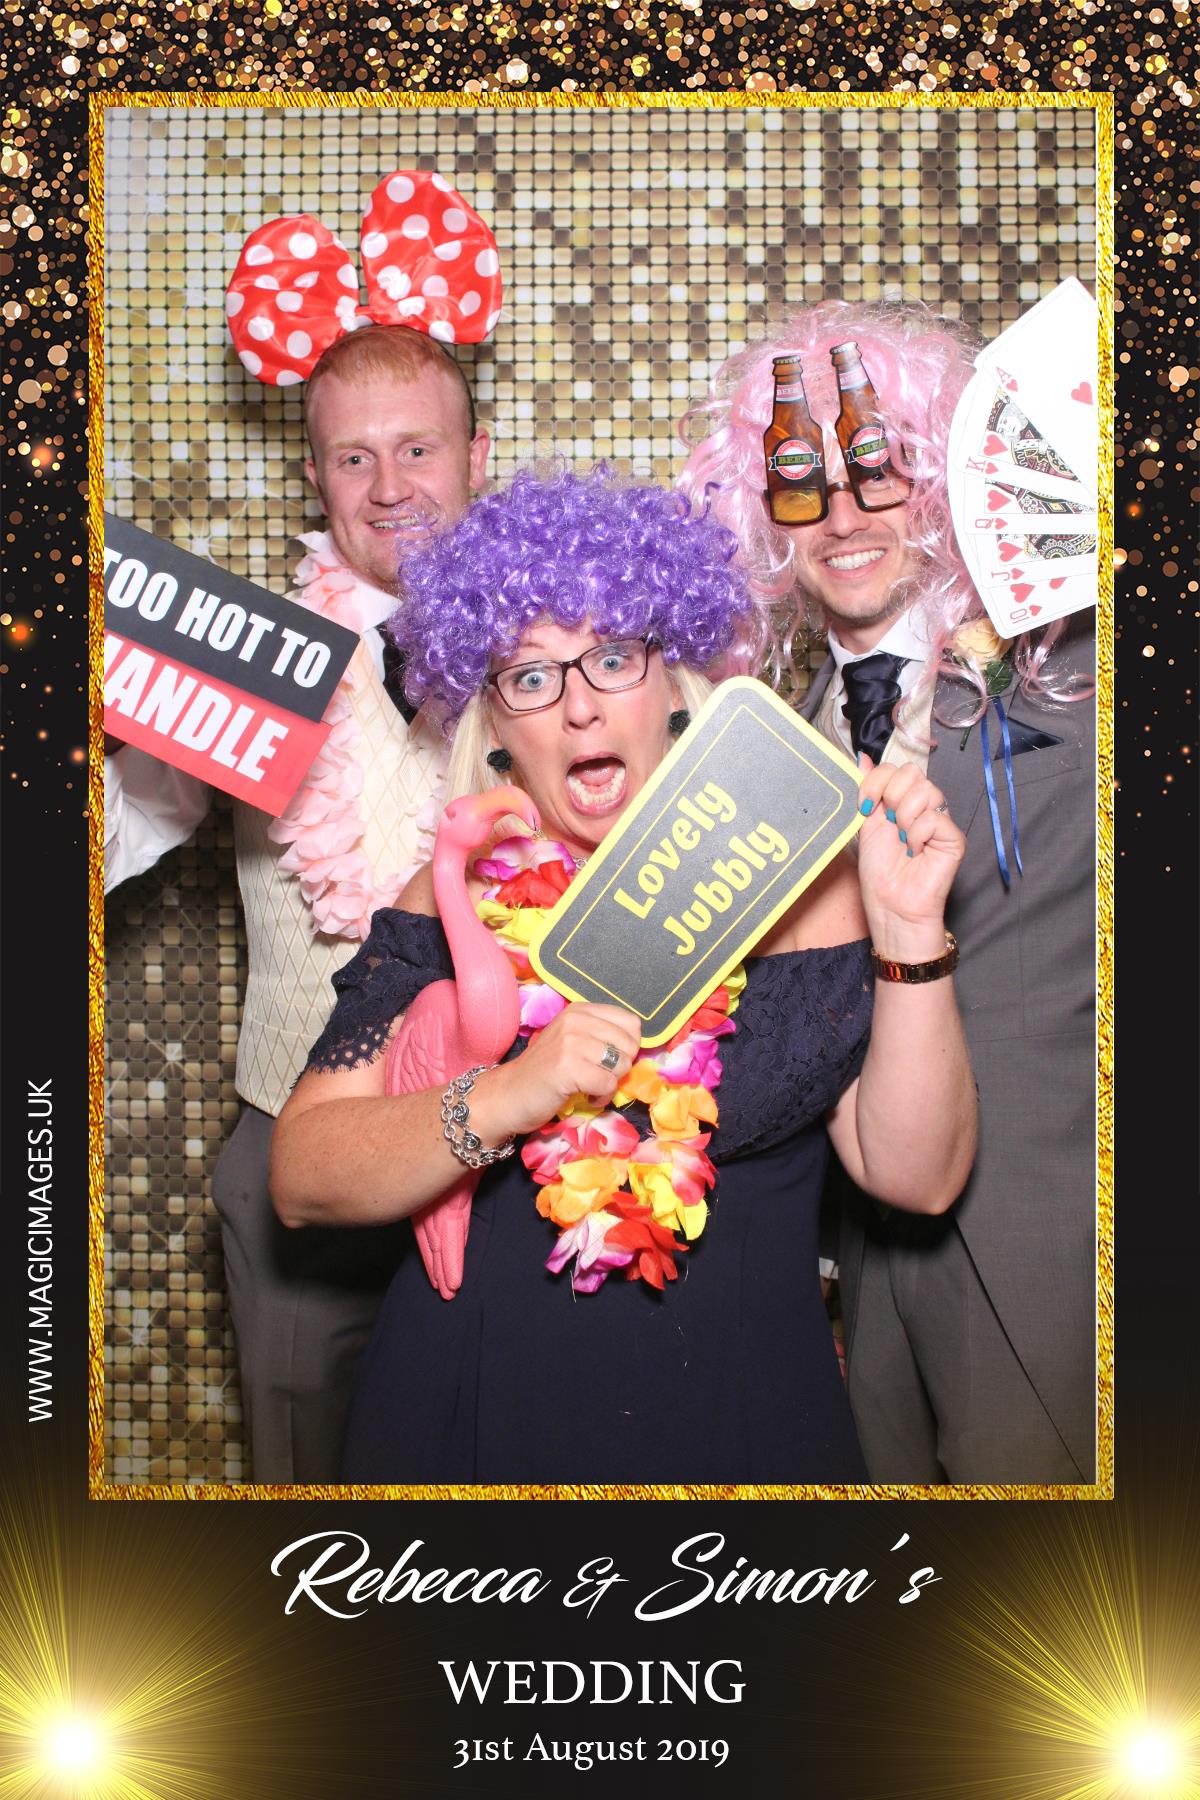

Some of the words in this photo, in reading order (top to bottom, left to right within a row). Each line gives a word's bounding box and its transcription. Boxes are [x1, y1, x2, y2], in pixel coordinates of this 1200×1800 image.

[995, 366, 1012, 383] A
[966, 456, 986, 473] K
[974, 518, 994, 529] Q
[991, 571, 1011, 581] J
[1009, 608, 1030, 624] 10
[174, 587, 276, 663] HOT
[271, 628, 332, 688] TO
[613, 781, 737, 920] Lovely
[662, 821, 790, 956] Jubbly
